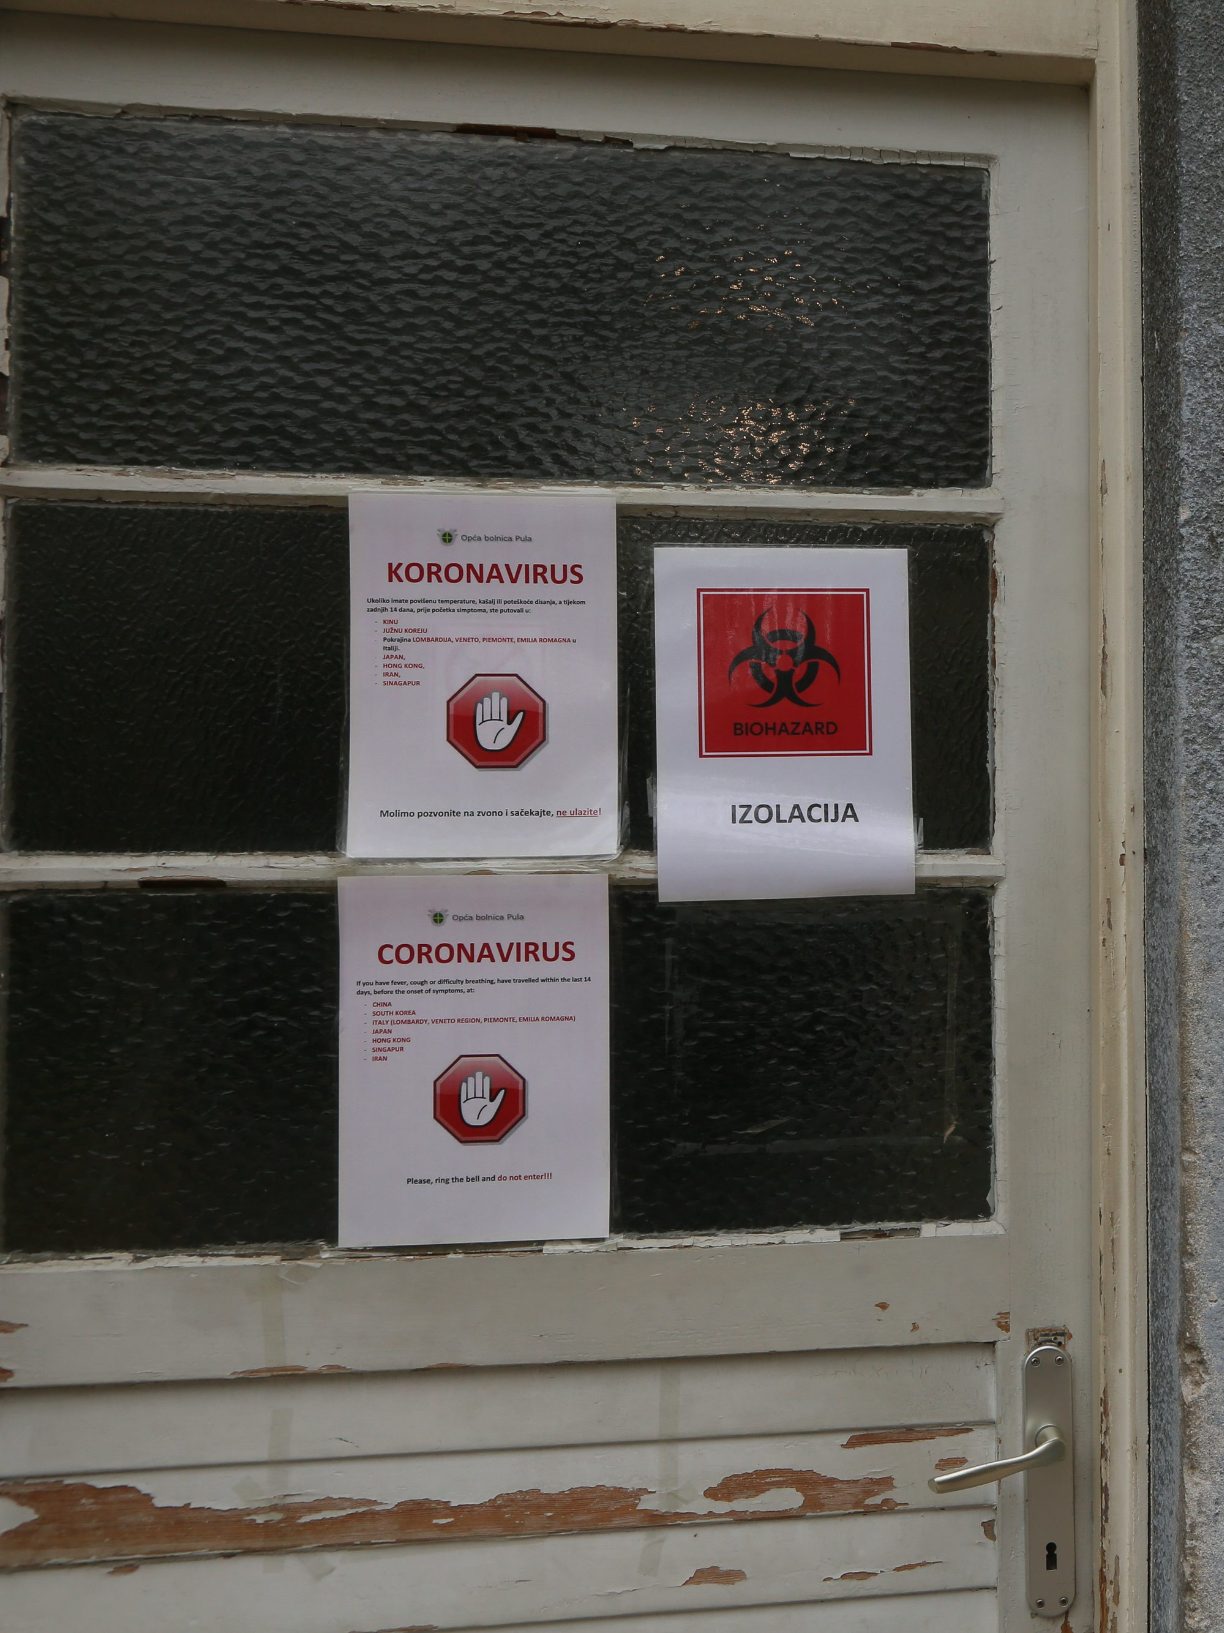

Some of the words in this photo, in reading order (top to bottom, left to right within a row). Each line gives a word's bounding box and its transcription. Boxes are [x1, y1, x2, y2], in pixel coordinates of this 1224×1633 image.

[461, 534, 482, 543] Opća
[388, 563, 583, 584] KORONAVIRUS
[733, 721, 838, 736] BIOHAZARD
[417, 809, 461, 818] pozvonite
[505, 809, 508, 817] i
[510, 809, 554, 818] sačekajte,
[570, 808, 601, 816] ulazite!
[731, 803, 859, 823] IZOLACIJA
[452, 913, 473, 922] Opća
[475, 913, 504, 921] bolnica
[507, 913, 524, 921] Pula
[378, 941, 575, 964] CORONAVIRUS
[435, 1176, 450, 1184] ring
[466, 1175, 480, 1183] bell
[497, 1174, 507, 1182] do
[509, 1173, 522, 1181] not
[524, 1172, 552, 1181] enter!!!
